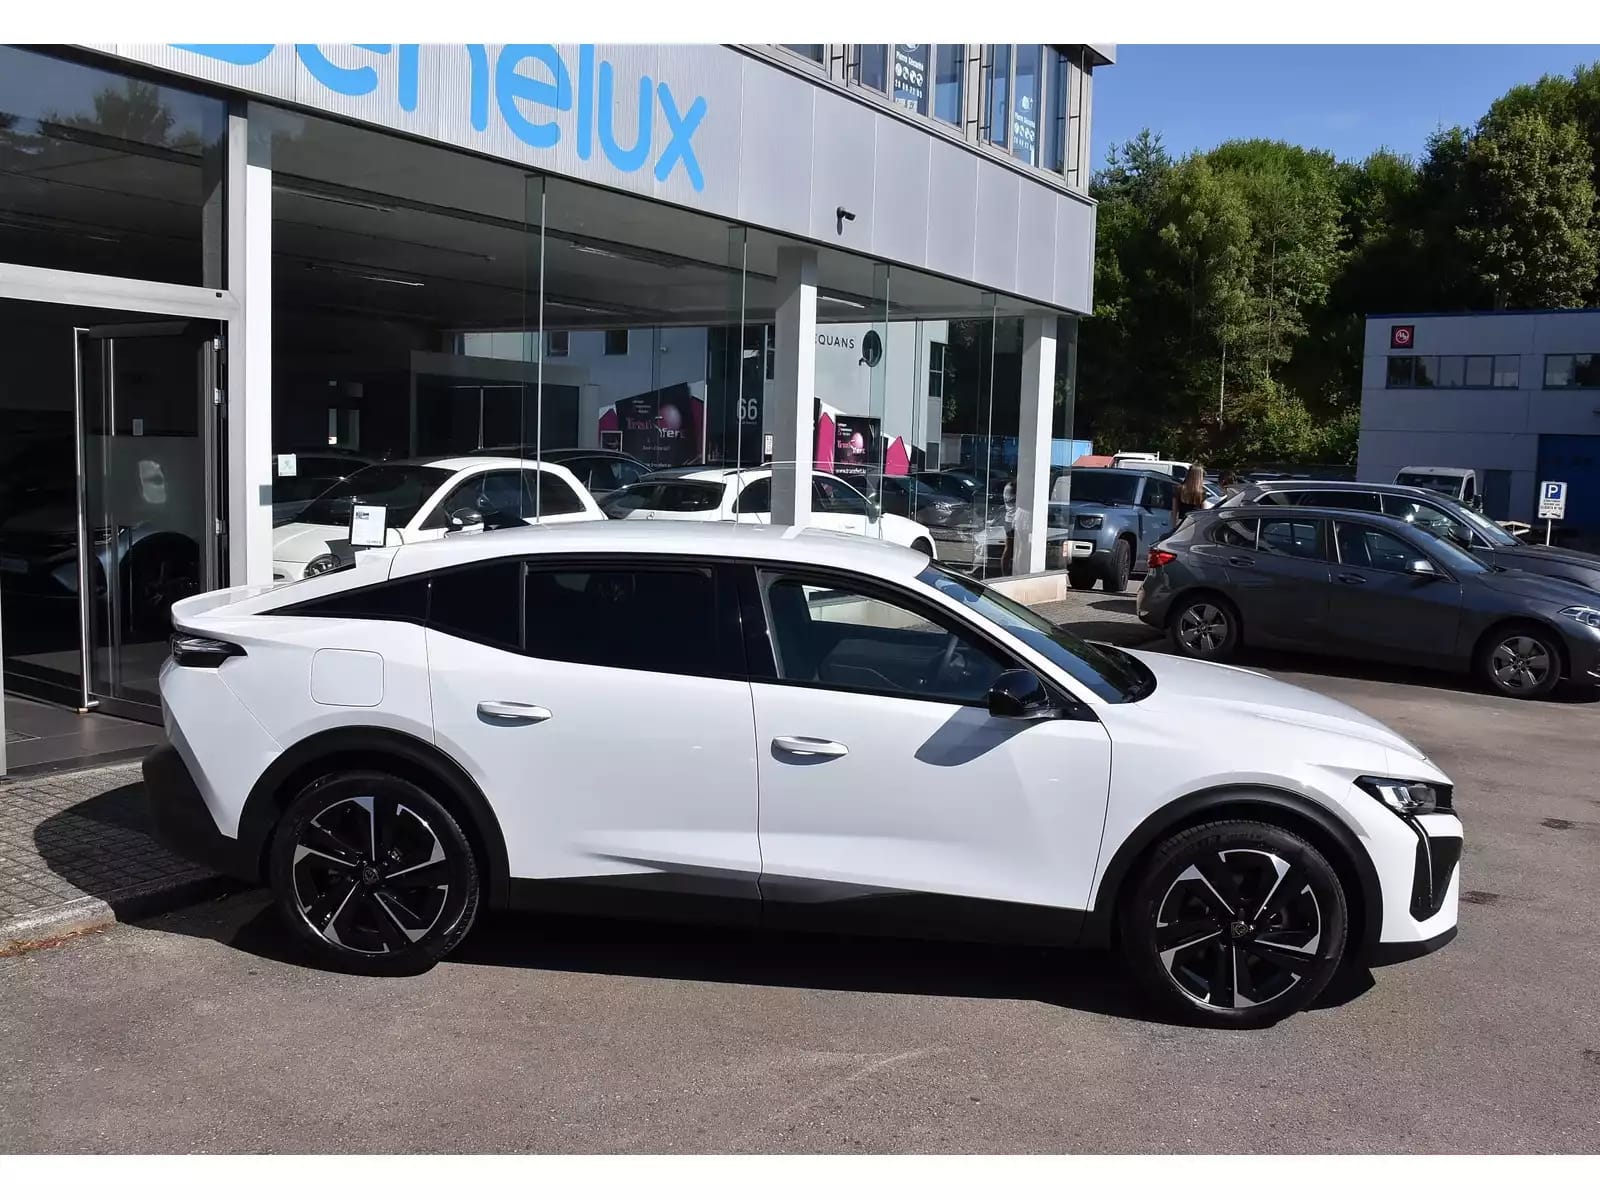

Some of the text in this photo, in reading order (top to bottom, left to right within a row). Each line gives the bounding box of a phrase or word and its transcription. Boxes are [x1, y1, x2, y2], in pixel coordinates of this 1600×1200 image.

[814, 334, 855, 349] QUANS
[736, 398, 758, 420] 66
[1548, 484, 1559, 498] P
